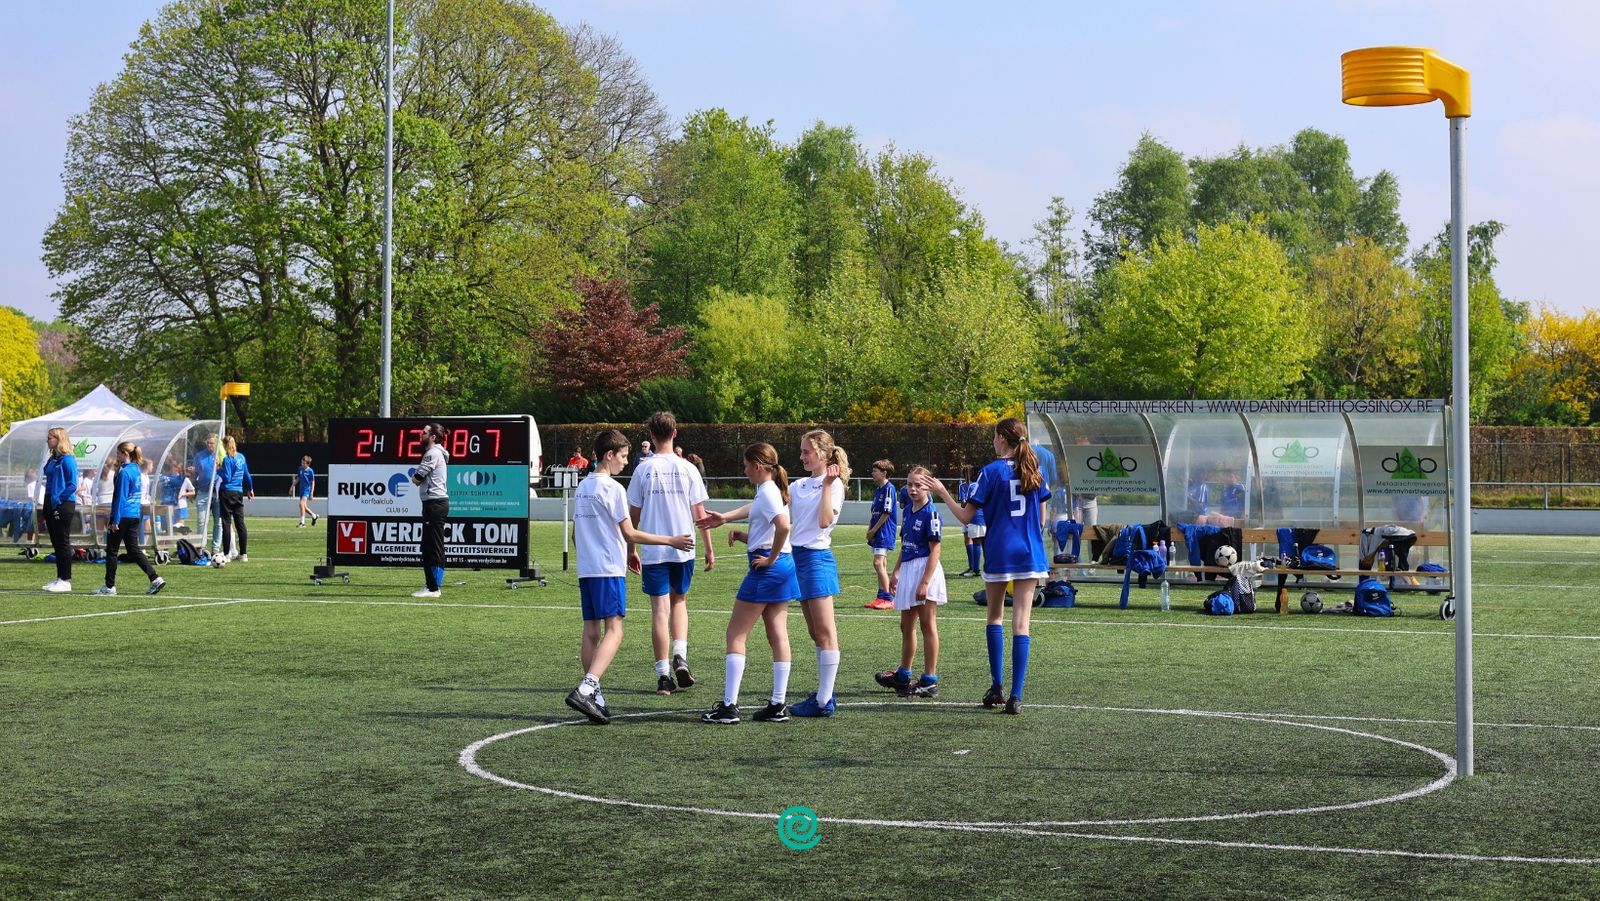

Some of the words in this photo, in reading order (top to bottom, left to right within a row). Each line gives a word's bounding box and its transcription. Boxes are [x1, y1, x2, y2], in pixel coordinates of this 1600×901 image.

[1033, 401, 1194, 413] METAALSCHRIJNWERKEN
[1207, 400, 1432, 413] WWW.DANNYHERTHOGSINOX.BE
[356, 429, 373, 457] 2
[373, 435, 384, 453] H
[469, 435, 480, 453] G
[486, 429, 500, 457] 7
[1087, 451, 1137, 477] d&p
[1381, 452, 1437, 478] d&p
[337, 482, 387, 499] RIJKO
[1009, 479, 1026, 517] 5
[340, 523, 354, 537] V
[371, 522, 466, 543] VERDCK
[472, 523, 519, 543] TOM
[351, 537, 364, 552] T
[374, 545, 417, 553] ALGEMENE
